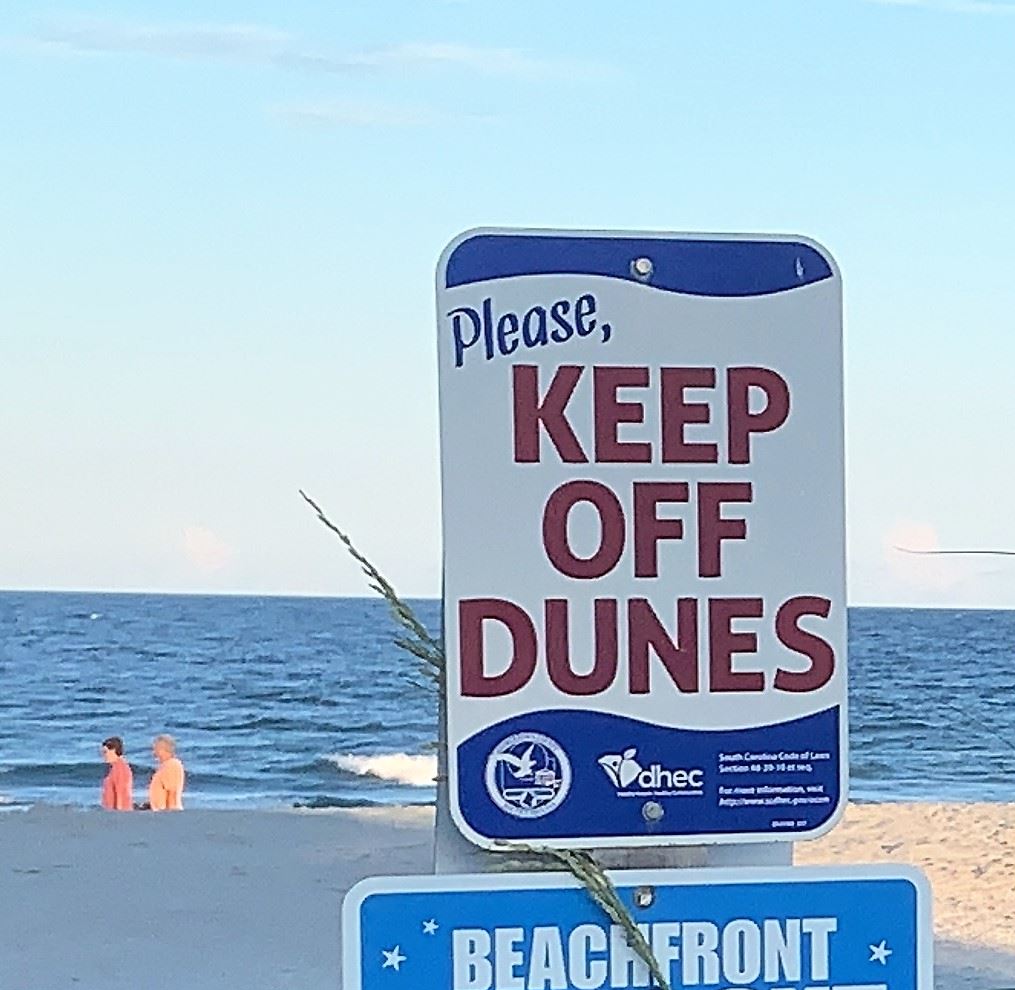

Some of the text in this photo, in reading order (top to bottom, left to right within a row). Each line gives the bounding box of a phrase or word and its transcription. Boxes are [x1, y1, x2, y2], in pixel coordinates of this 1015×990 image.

[447, 294, 611, 367] Please,
[512, 364, 791, 464] KEEP
[542, 480, 753, 580] OFF
[458, 595, 836, 697] DUNES
[638, 764, 704, 788] dhec
